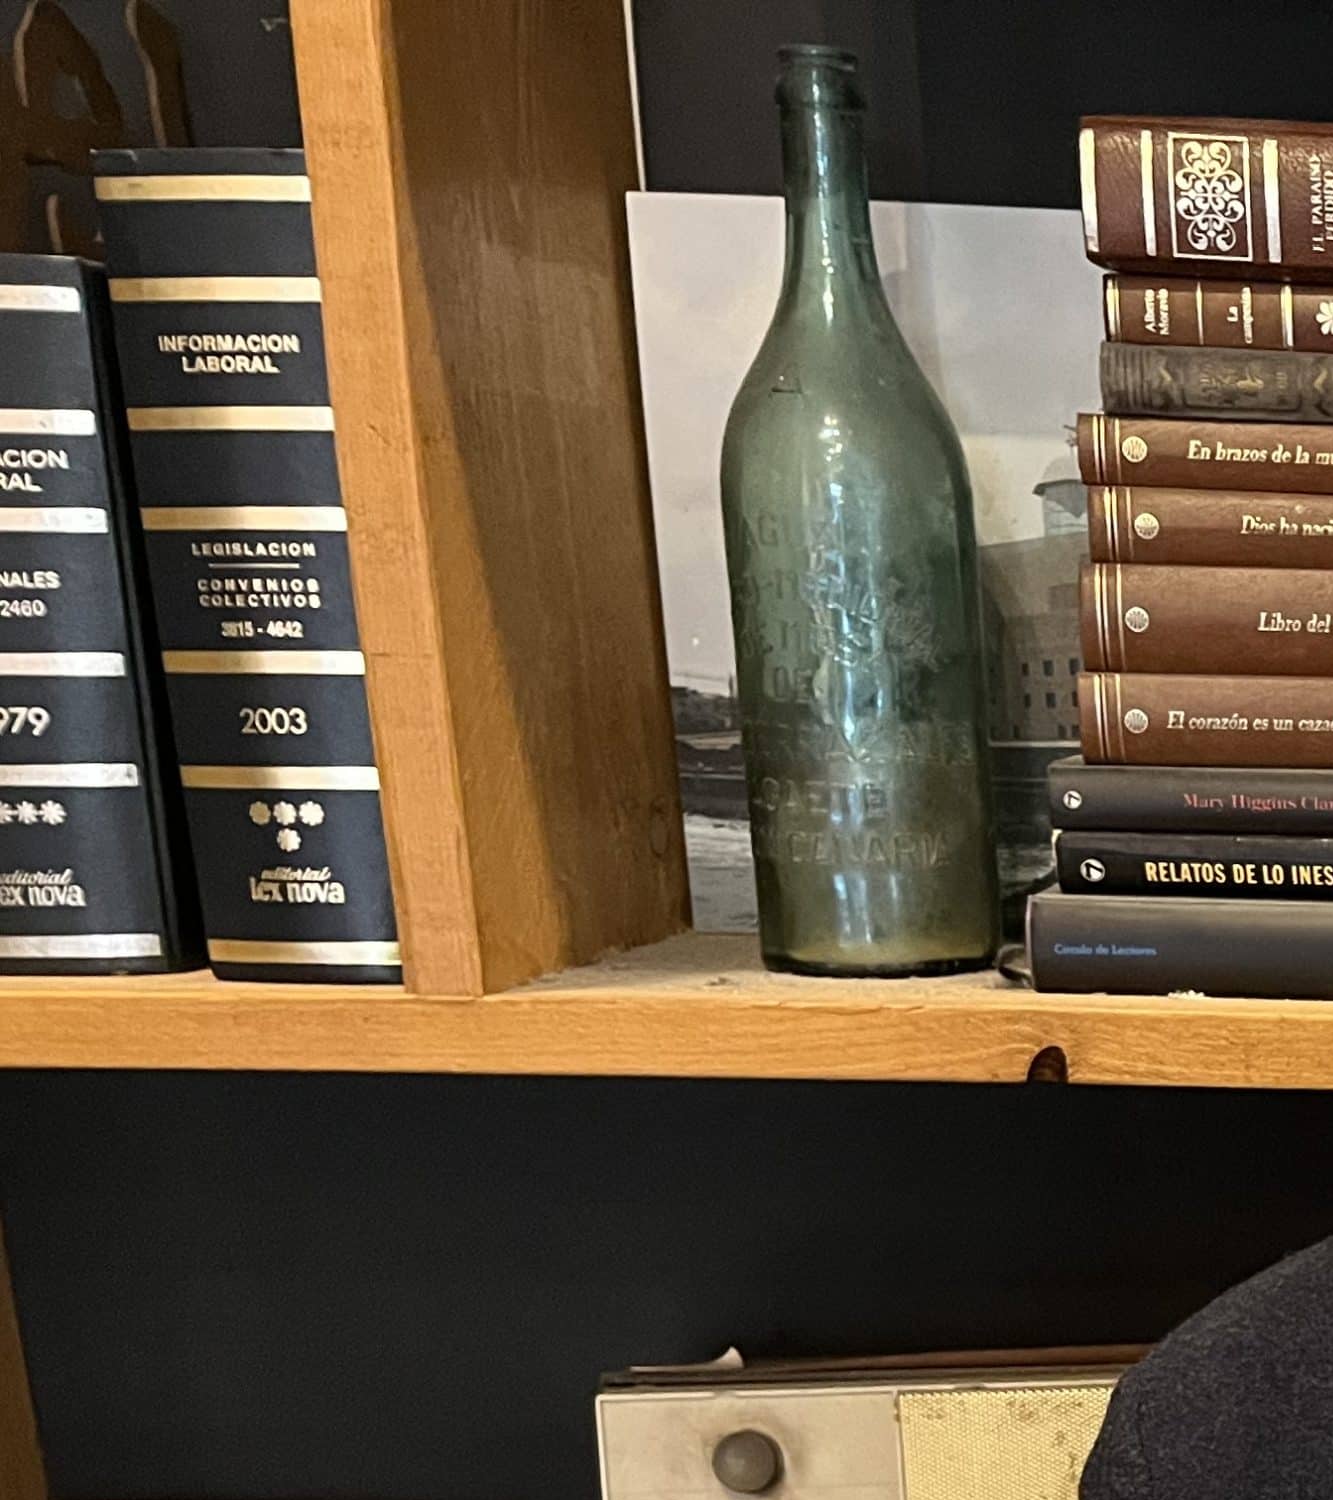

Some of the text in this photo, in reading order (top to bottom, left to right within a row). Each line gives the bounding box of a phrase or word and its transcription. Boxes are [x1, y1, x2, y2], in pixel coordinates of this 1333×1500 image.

[158, 335, 300, 353] INFORMACION
[181, 355, 281, 373] LABORAL
[0, 449, 69, 469] CION
[1187, 439, 1211, 461] En
[1215, 442, 1267, 462] brazos
[1271, 443, 1291, 464] de
[1295, 445, 1310, 465] la
[1240, 514, 1276, 535] Dios
[1279, 516, 1298, 536] ha
[191, 542, 317, 557] LEGISLACION
[197, 578, 320, 593] CONVENIOS
[199, 593, 321, 608] COLECTIVOS
[1257, 611, 1301, 632] Libro
[1306, 613, 1331, 634] del
[239, 707, 308, 735] 2003
[1167, 710, 1185, 729] El
[1188, 712, 1248, 731] corazón
[1252, 716, 1268, 731] es
[1273, 717, 1293, 732] un
[1183, 793, 1225, 810] Mary
[1231, 794, 1297, 812] Higgins
[1144, 861, 1226, 883] RELATOS
[1232, 864, 1257, 885] DE
[1262, 865, 1284, 886] LO
[28, 884, 87, 906] nova
[286, 881, 345, 904] nova
